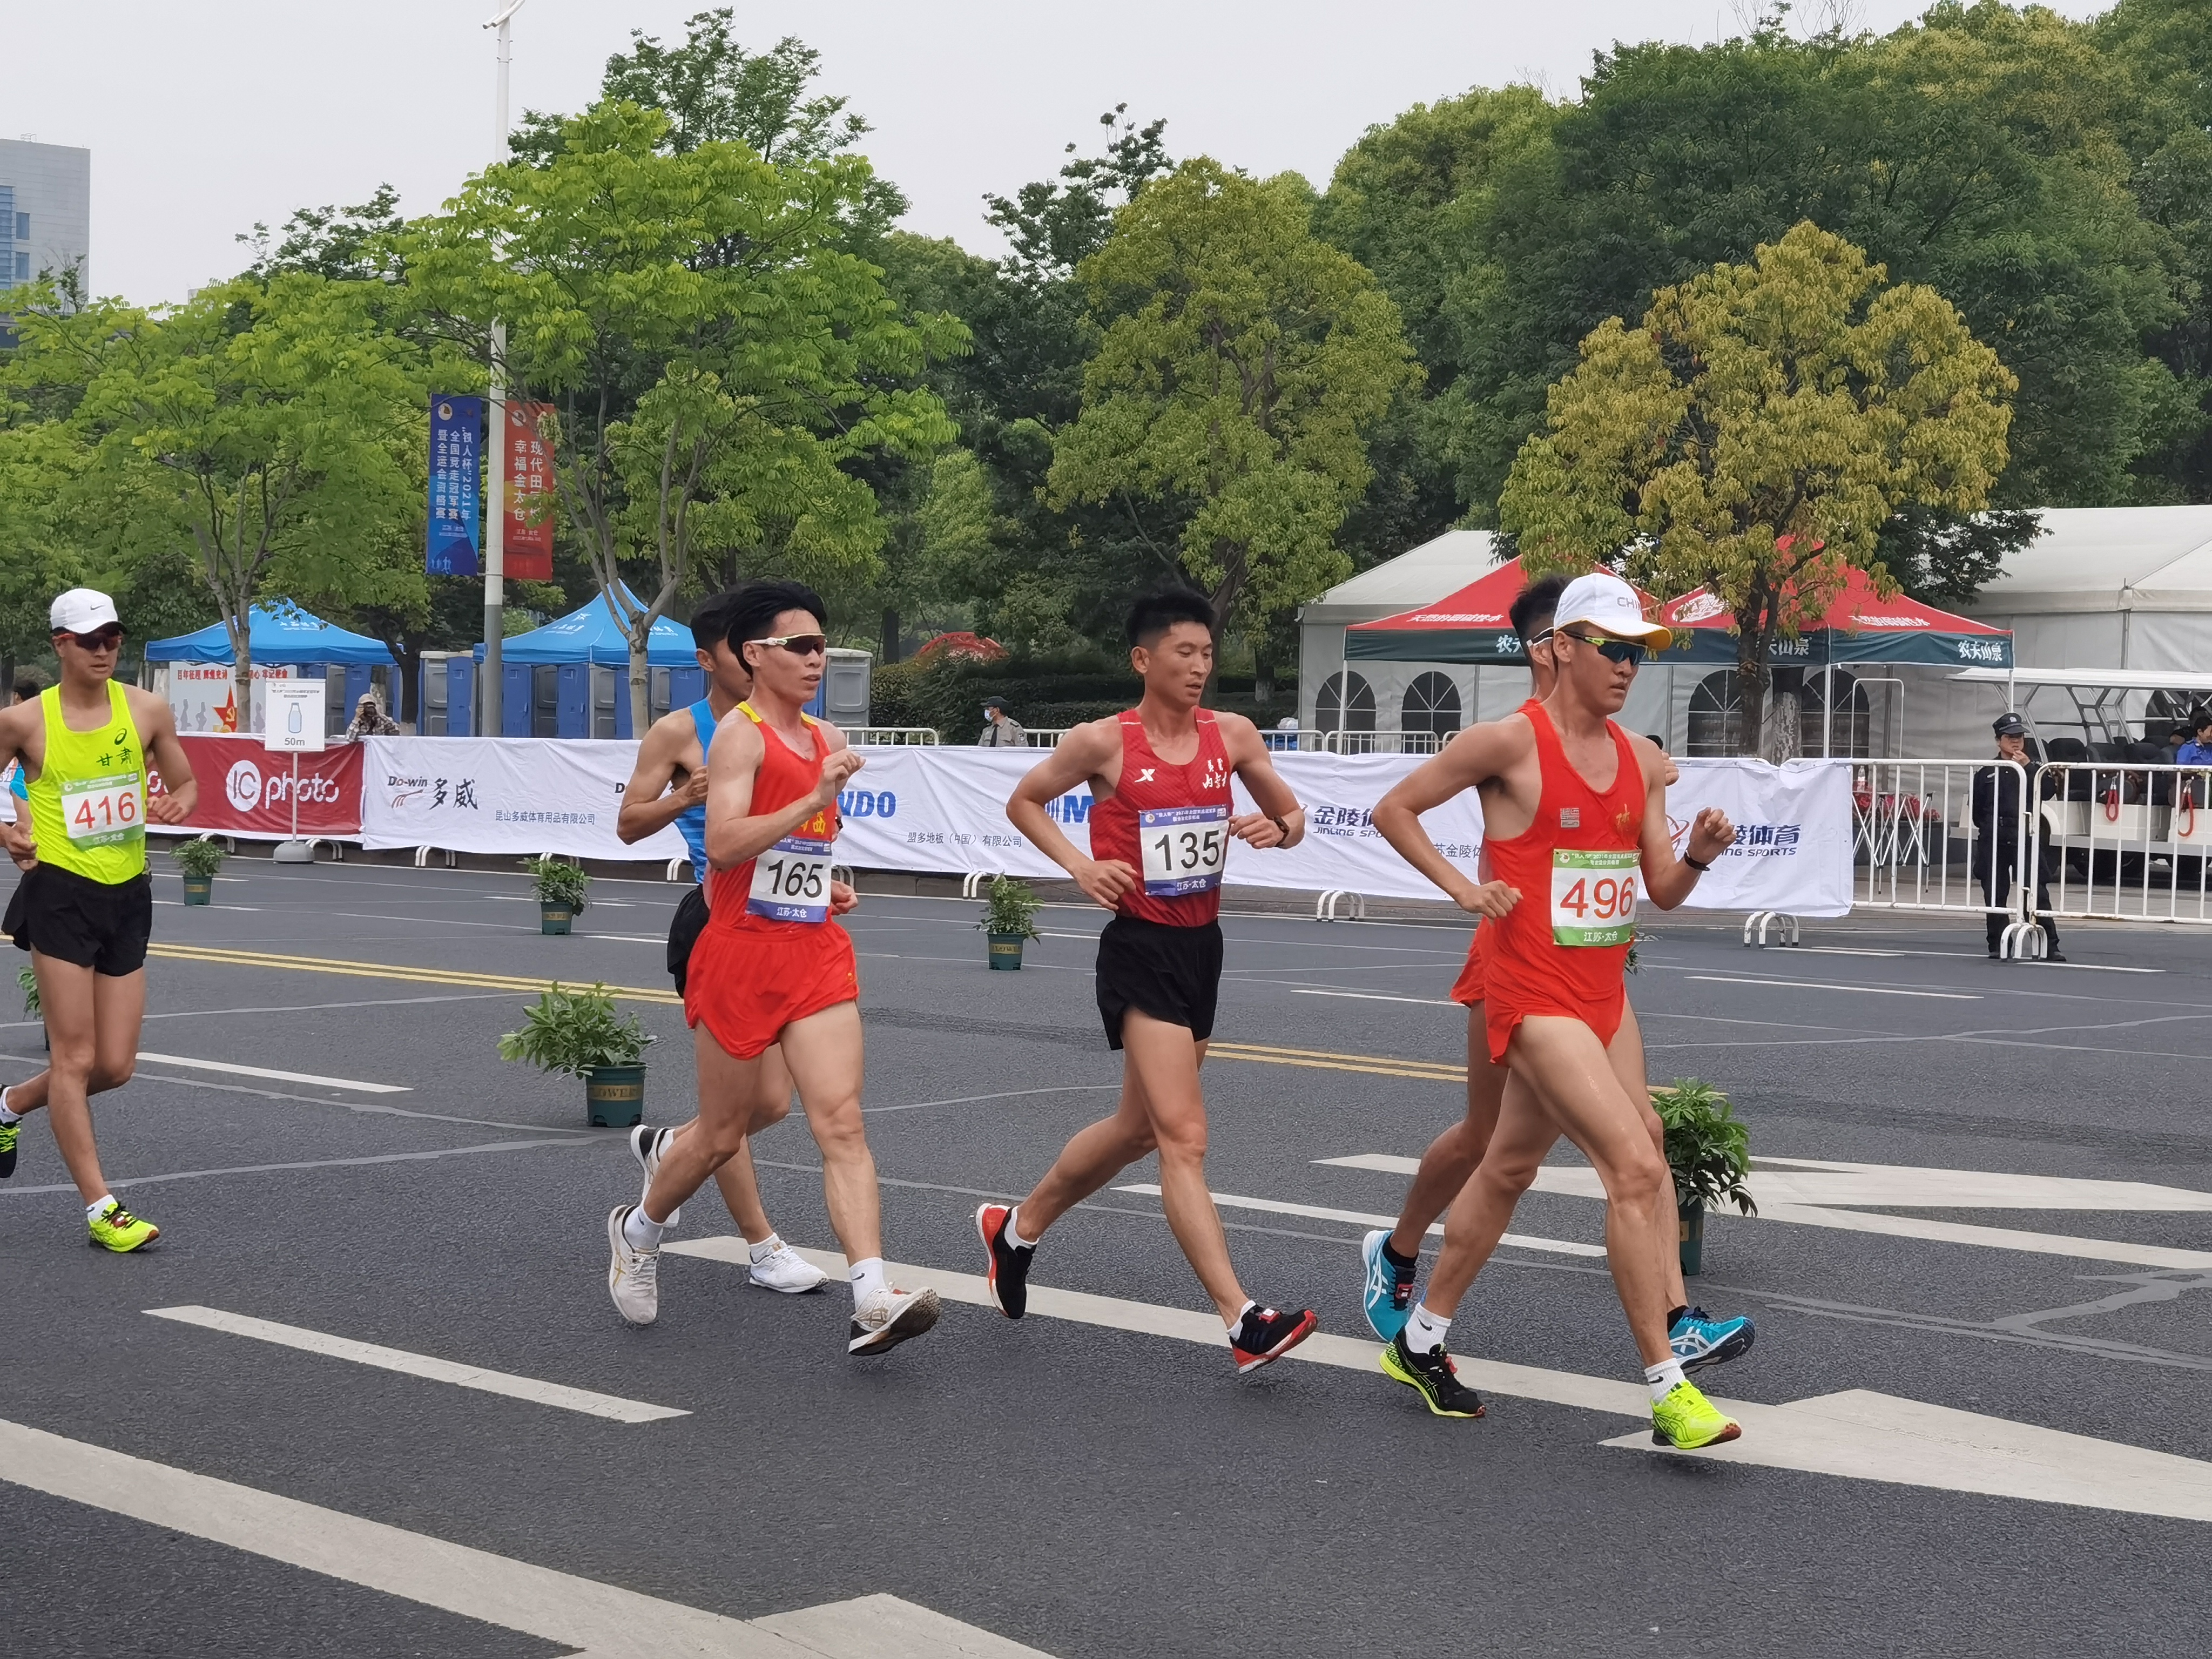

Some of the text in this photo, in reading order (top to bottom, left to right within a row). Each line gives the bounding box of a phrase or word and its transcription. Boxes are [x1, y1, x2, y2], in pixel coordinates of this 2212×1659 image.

[448, 430, 460, 520] 全国竞走冠军赛
[514, 439, 527, 521] 幸福金太仓
[530, 440, 543, 520] 现代田
[1767, 637, 1810, 656] 夫山泉
[1957, 640, 2002, 662] 农夫山泉
[284, 737, 305, 746] 50m
[96, 747, 133, 766] 甘肃
[233, 770, 339, 810] IC photo
[388, 775, 428, 788] Do-win
[429, 777, 478, 810] 多威
[838, 791, 896, 818] NDO
[75, 792, 136, 829] 416
[495, 810, 595, 825] 昆山多威体育用品有限公司
[1359, 830, 1385, 838] SPO
[1733, 824, 1802, 846] 陵体育
[1155, 830, 1219, 871] 135
[1434, 842, 1482, 859] 苏金陵体
[1748, 847, 1797, 857] SPORTS
[767, 859, 824, 899] 165
[1177, 878, 1207, 891] 江苏·太仓
[1560, 876, 1635, 919] 496
[777, 907, 807, 918] 江苏·太仓
[1583, 930, 1618, 942] 江苏·太仓
